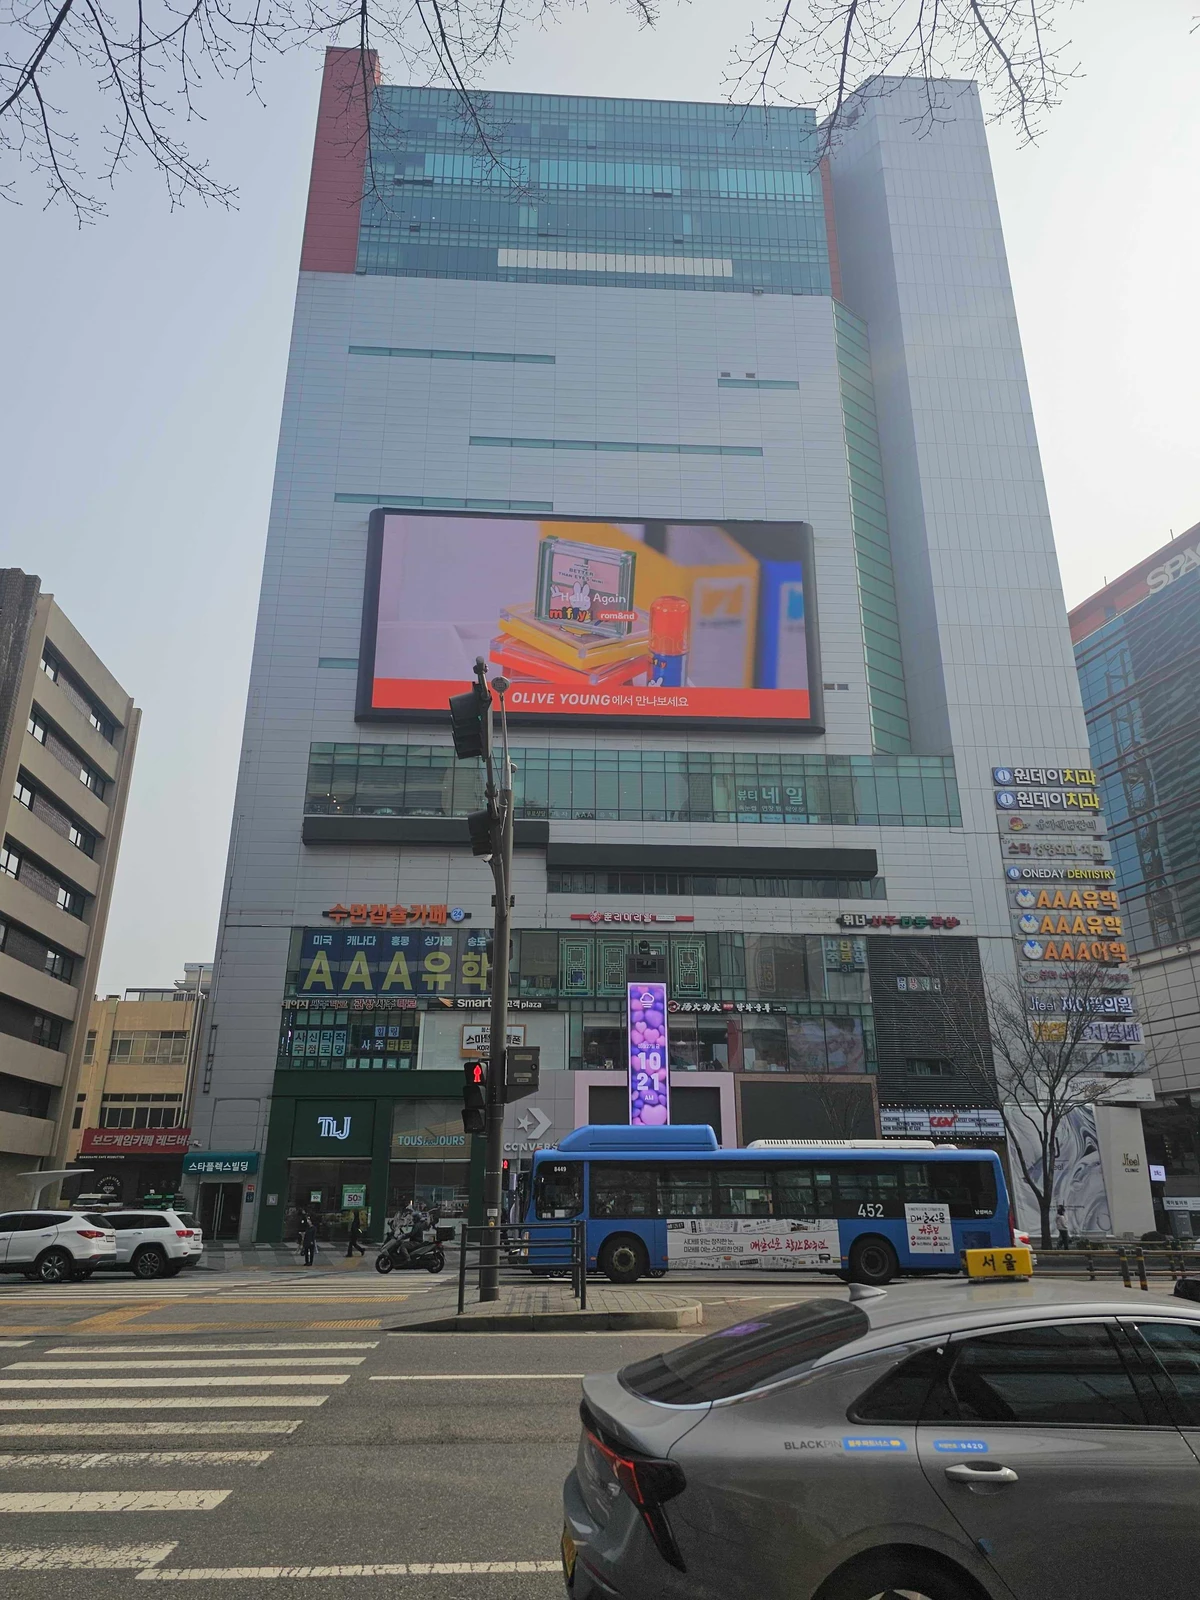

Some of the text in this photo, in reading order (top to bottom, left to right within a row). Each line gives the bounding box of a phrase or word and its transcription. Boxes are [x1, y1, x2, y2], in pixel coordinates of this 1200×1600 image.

[568, 567, 594, 577] BETTER
[1147, 541, 1200, 594] SPA
[593, 593, 627, 605] Again
[549, 606, 587, 622] miffy
[600, 612, 635, 620] rom&nd
[511, 692, 555, 705] OLIVE
[635, 695, 689, 707] 만나보세요
[1014, 768, 1097, 786] 원데이치과
[737, 786, 803, 805] 뷰티 네일
[1017, 791, 1099, 809] 원데이치과
[1008, 842, 1031, 856] 스타
[1022, 868, 1065, 879] ONEDAY
[1067, 868, 1116, 880] DENTISTRY
[1036, 889, 1119, 910] AAA유학
[329, 903, 448, 925] 수면캡슐카페
[843, 914, 866, 926] 위너
[872, 915, 896, 928] 사주
[900, 916, 927, 929] 타로
[1040, 914, 1123, 935] AAA유학
[313, 935, 487, 947] 미국 캐나다 홍콩 싱가폴 송도
[1044, 941, 1128, 962] AAA어학
[302, 950, 490, 991] AAA유학
[841, 964, 854, 973] 3F
[457, 998, 492, 1008] smart
[521, 1001, 542, 1009] plaza
[293, 1032, 306, 1054] 사주
[307, 1032, 319, 1055] 신점
[320, 1032, 333, 1055] 타로
[334, 1032, 346, 1055] 작명
[637, 1052, 661, 1070] 10
[636, 1072, 660, 1091] 21
[317, 1116, 352, 1140] TLJ
[91, 1134, 154, 1147] 보드게임카페
[398, 1135, 423, 1146] TOUS
[435, 1136, 466, 1146] JOURS
[503, 1142, 558, 1151] CONVERS
[188, 1161, 249, 1172] 스타플렉스빌딩
[1122, 1153, 1140, 1166] Jfeel
[857, 1203, 885, 1218] 452
[960, 1442, 984, 1450] 9420
